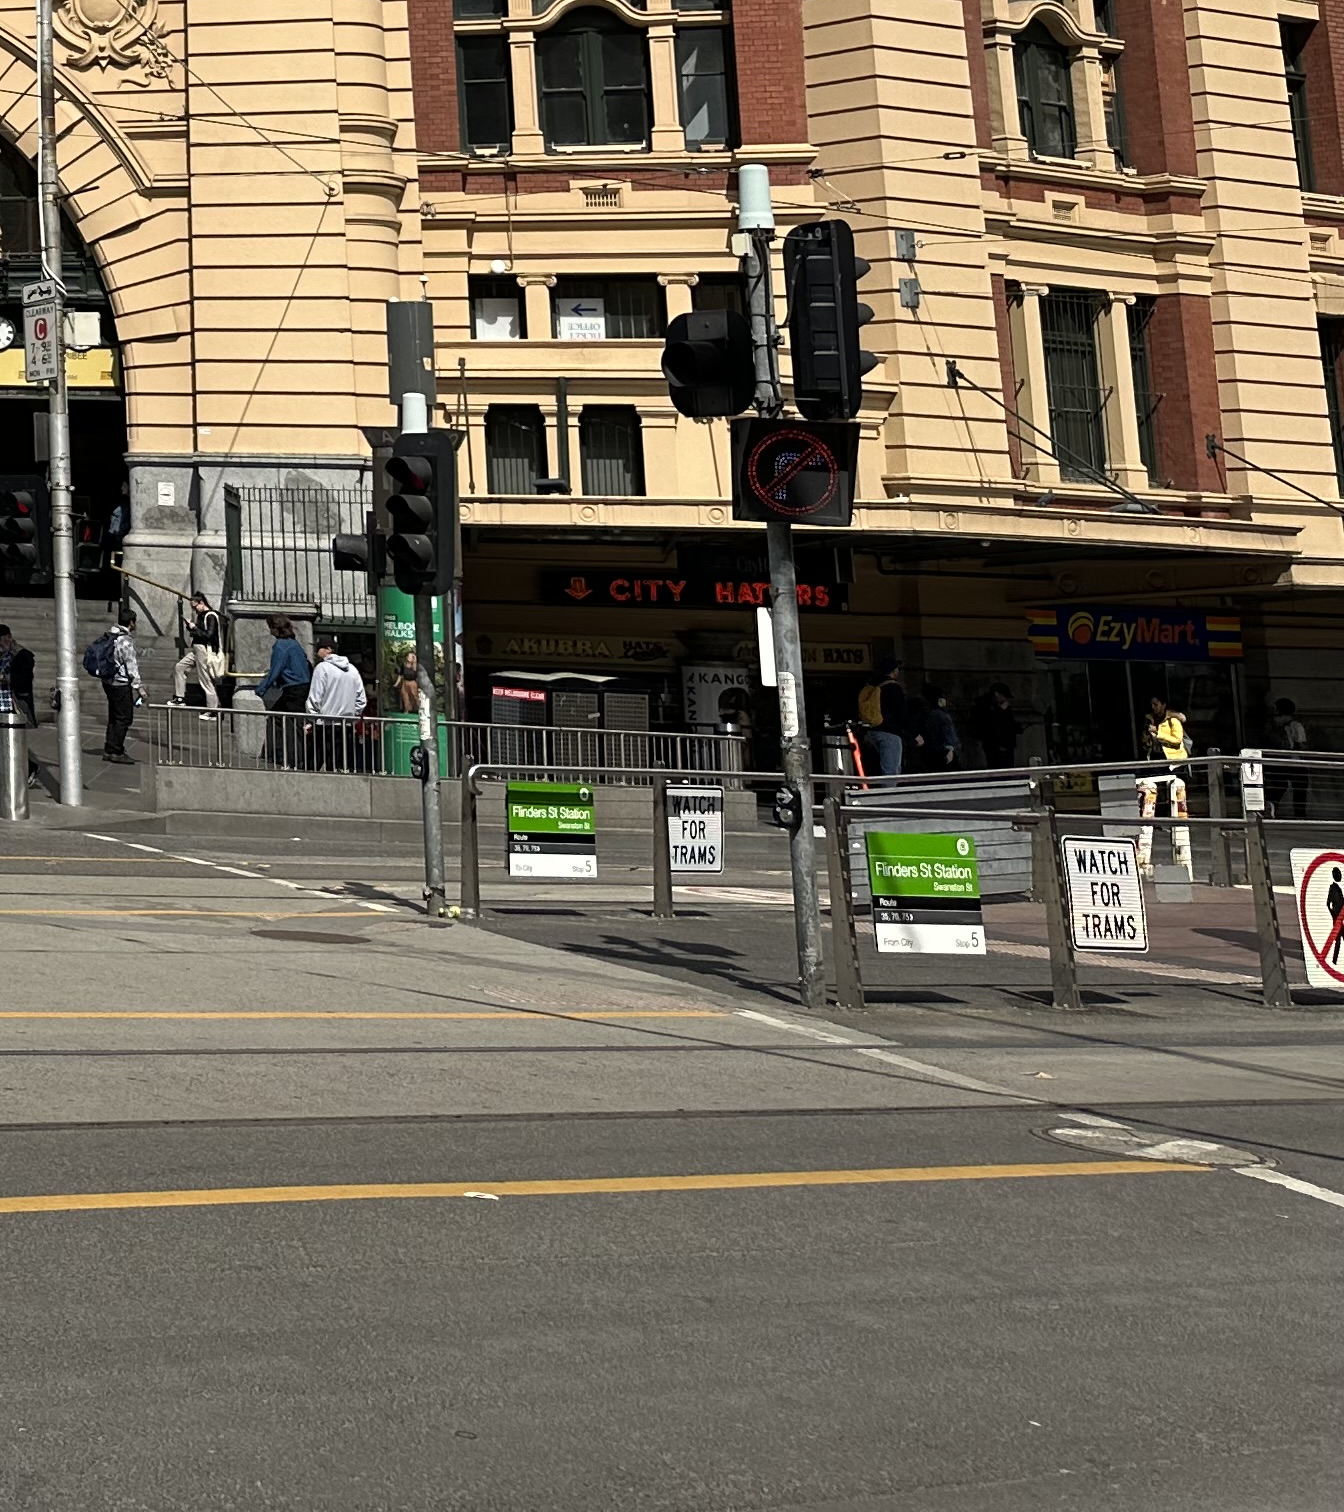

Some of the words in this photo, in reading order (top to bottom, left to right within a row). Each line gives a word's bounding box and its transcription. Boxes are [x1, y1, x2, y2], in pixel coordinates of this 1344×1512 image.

[609, 579, 687, 602] CITY
[715, 581, 830, 607] HATRS
[1095, 615, 1196, 650] EzyMart
[502, 637, 613, 658] AKUBRA
[823, 648, 864, 665] HATS
[512, 805, 547, 819] Flinders
[548, 806, 559, 819] St
[559, 806, 591, 820] Station
[672, 795, 716, 815] WATCH
[557, 821, 584, 829] Swanston
[583, 821, 591, 830] St
[681, 820, 706, 840] FOR
[513, 833, 529, 841] Route
[672, 845, 716, 865] TRAMS
[1073, 848, 1129, 875] WATCH
[522, 864, 533, 873] City
[572, 865, 584, 874] Stop
[585, 859, 592, 873] 5
[875, 861, 918, 878] Flinders
[919, 862, 933, 879] St
[933, 862, 972, 880] Station
[933, 881, 965, 892] Swanston
[965, 882, 973, 892] St
[1090, 881, 1121, 908] FOR
[879, 897, 897, 907] Route
[1082, 913, 1137, 940] TRAMS
[883, 937, 900, 947] From
[900, 937, 914, 949] City
[955, 938, 971, 949] Stop
[971, 931, 979, 948] 5
